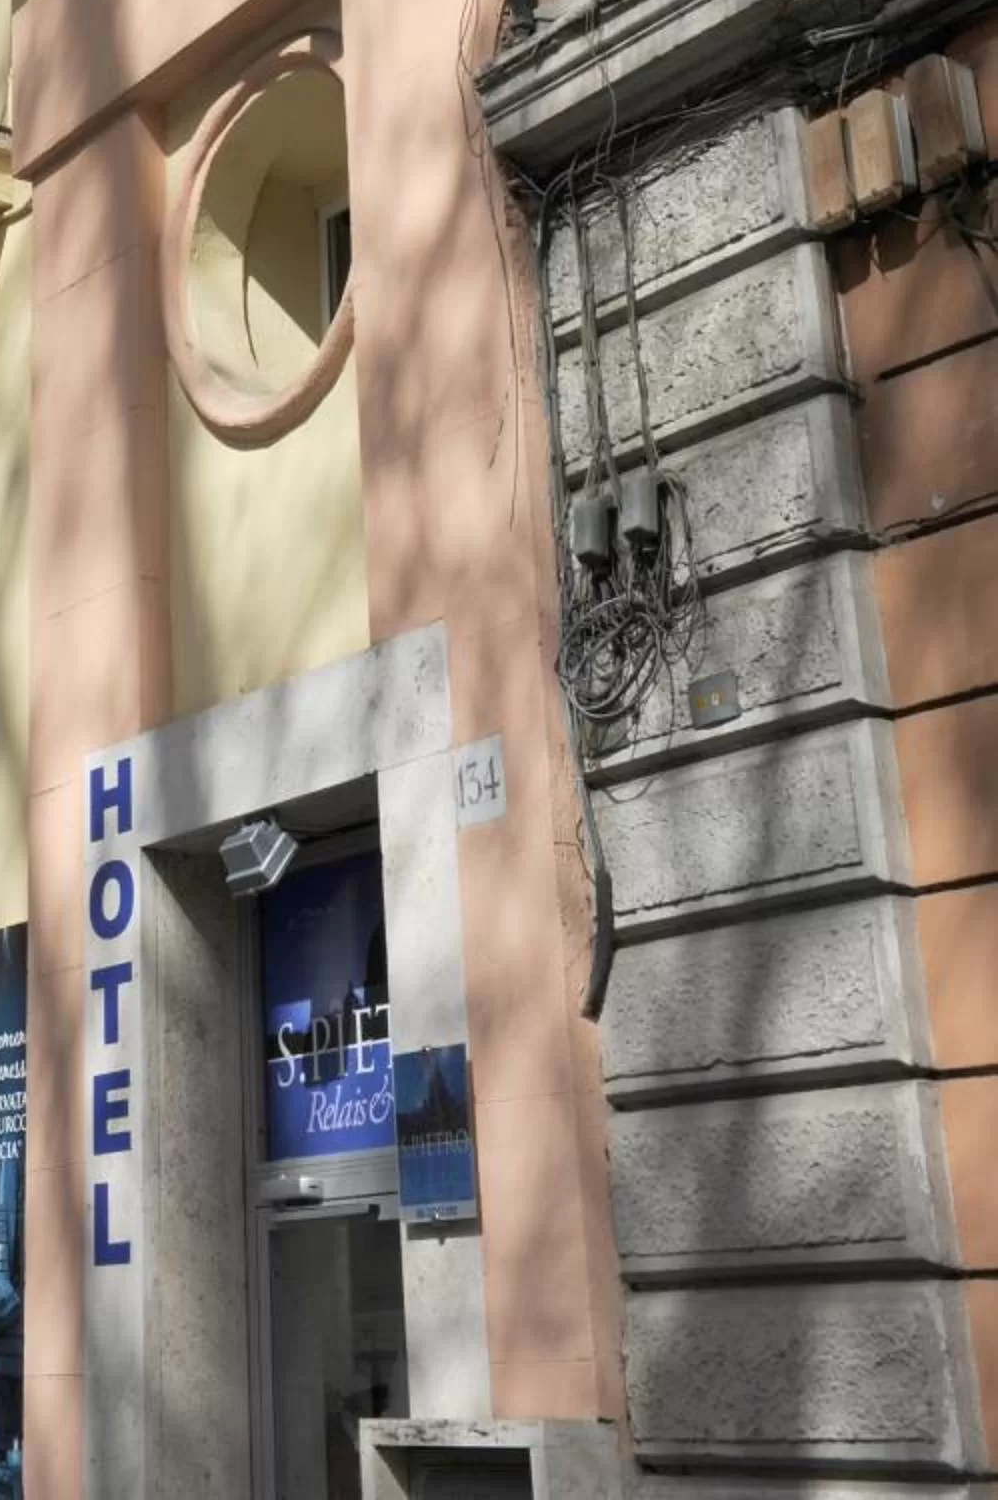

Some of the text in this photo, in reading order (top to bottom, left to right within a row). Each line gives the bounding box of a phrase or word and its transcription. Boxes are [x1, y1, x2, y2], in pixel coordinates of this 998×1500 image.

[457, 755, 501, 809] 134
[90, 756, 135, 1268] HOTEL
[305, 1083, 367, 1134] Relais
